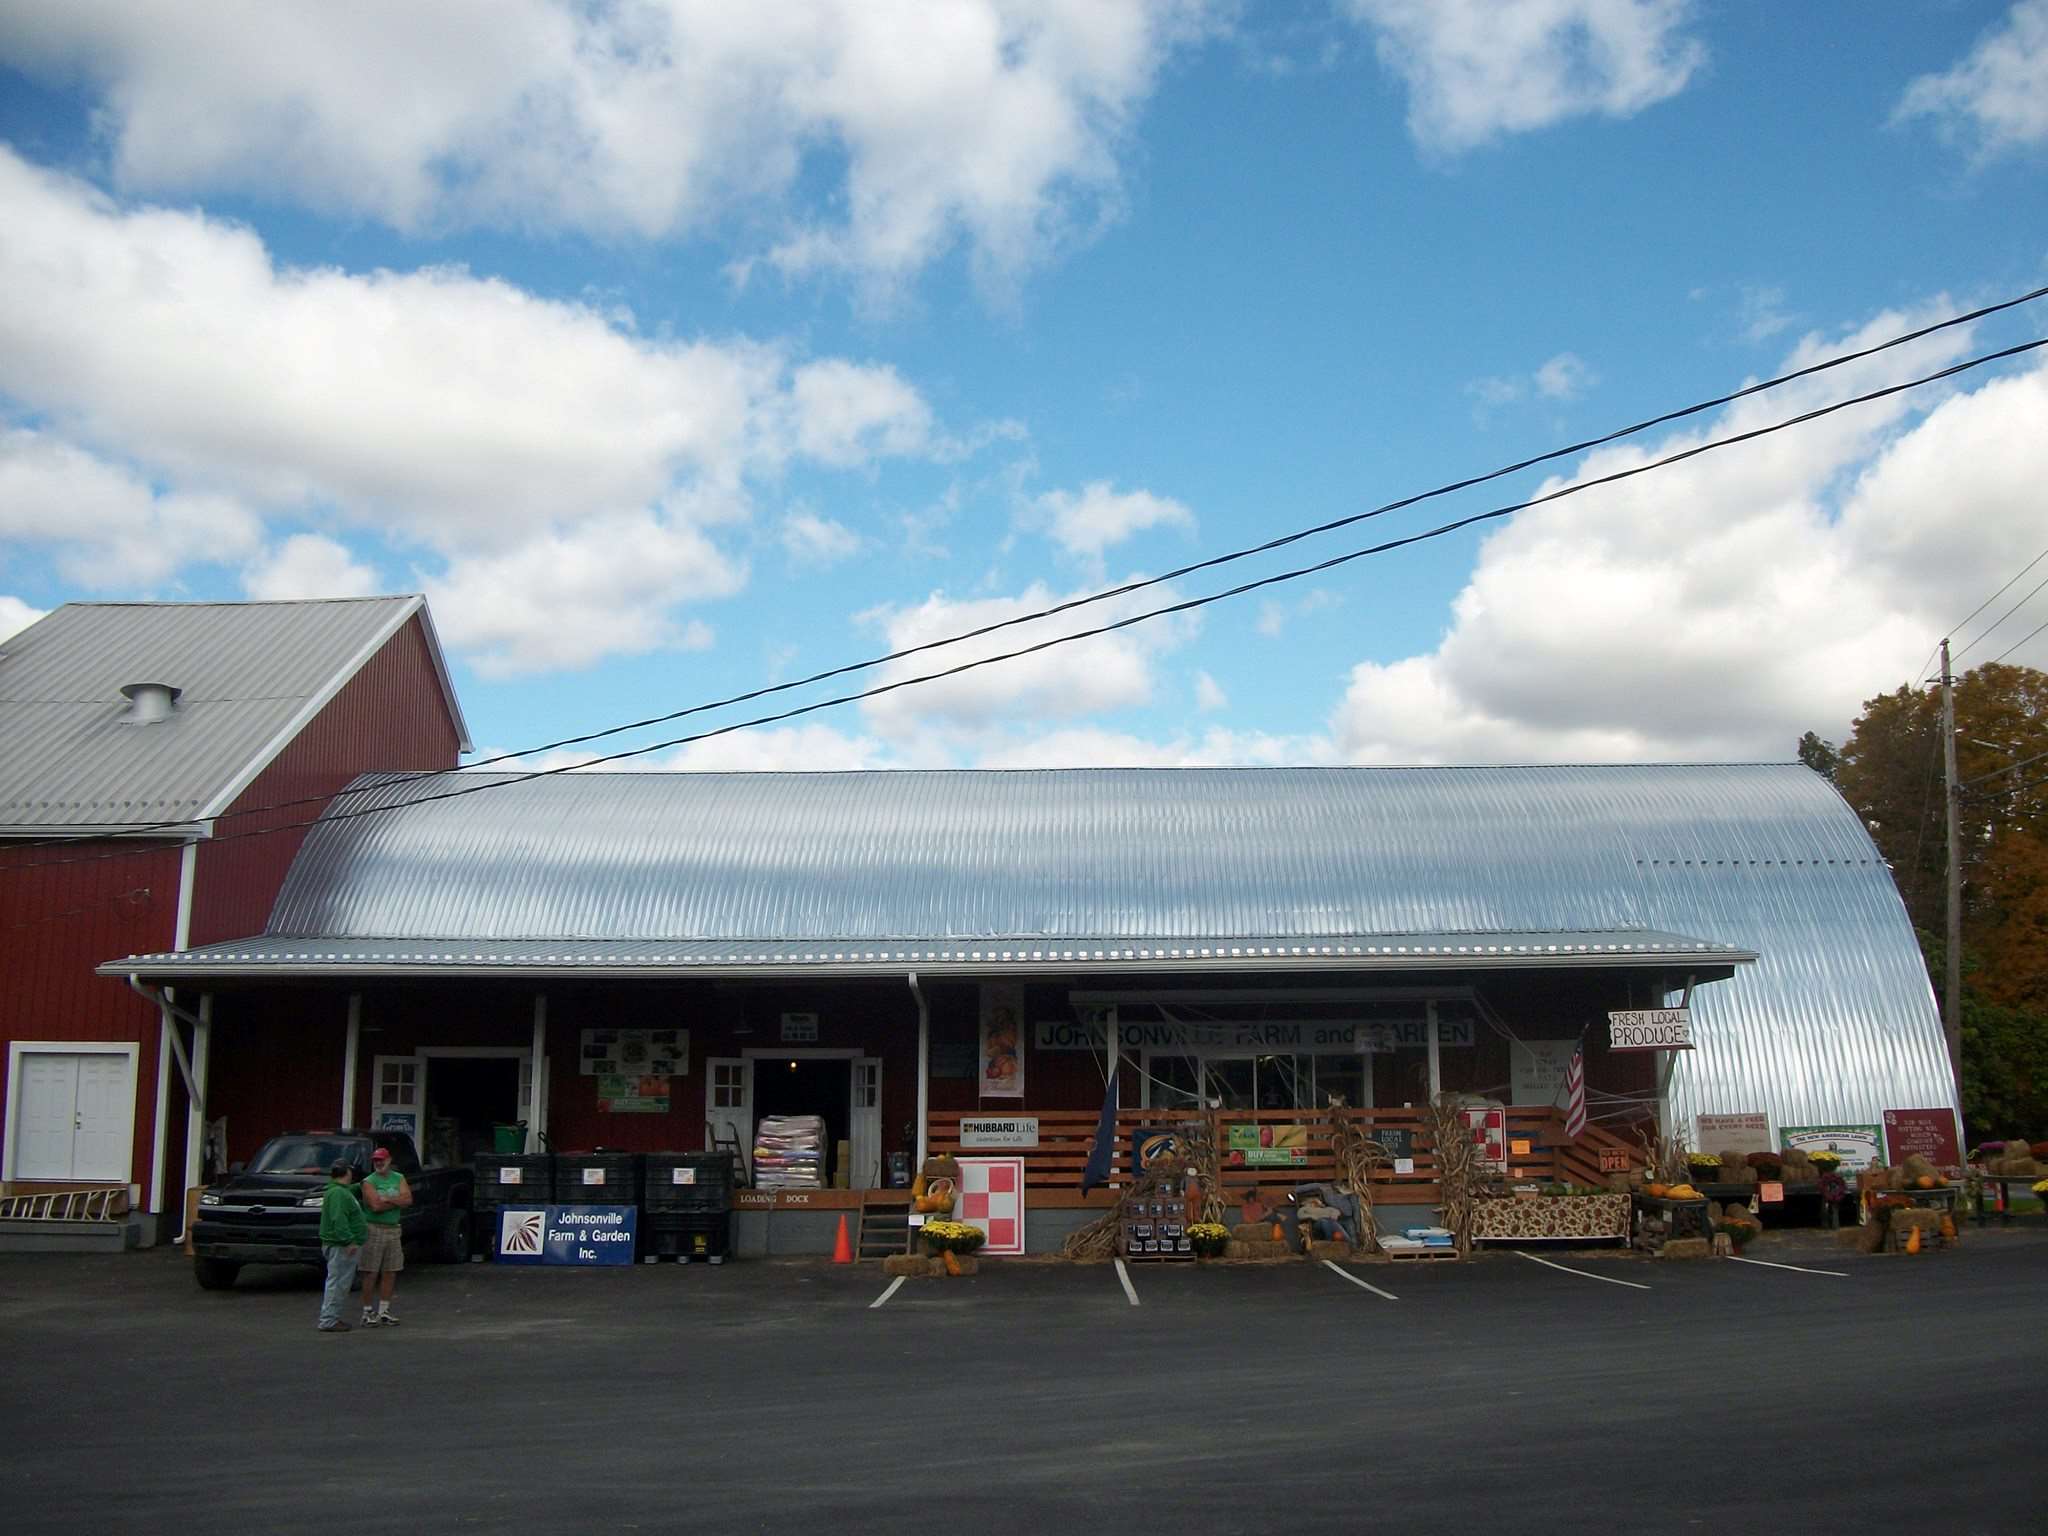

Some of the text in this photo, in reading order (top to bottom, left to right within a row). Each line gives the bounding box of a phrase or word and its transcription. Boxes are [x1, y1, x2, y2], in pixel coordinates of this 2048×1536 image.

[1612, 1011, 1687, 1026] FRESH LOCAL
[1314, 1024, 1355, 1044] and
[1613, 1026, 1685, 1045] PRODUCE
[974, 1122, 1036, 1133] HUBBARD Life
[1600, 1157, 1629, 1169] OPEN
[786, 1194, 809, 1203] DOCK
[558, 1212, 623, 1225] Johnsonville
[548, 1229, 630, 1242] Farm & Garden
[578, 1247, 597, 1259] Inc.
